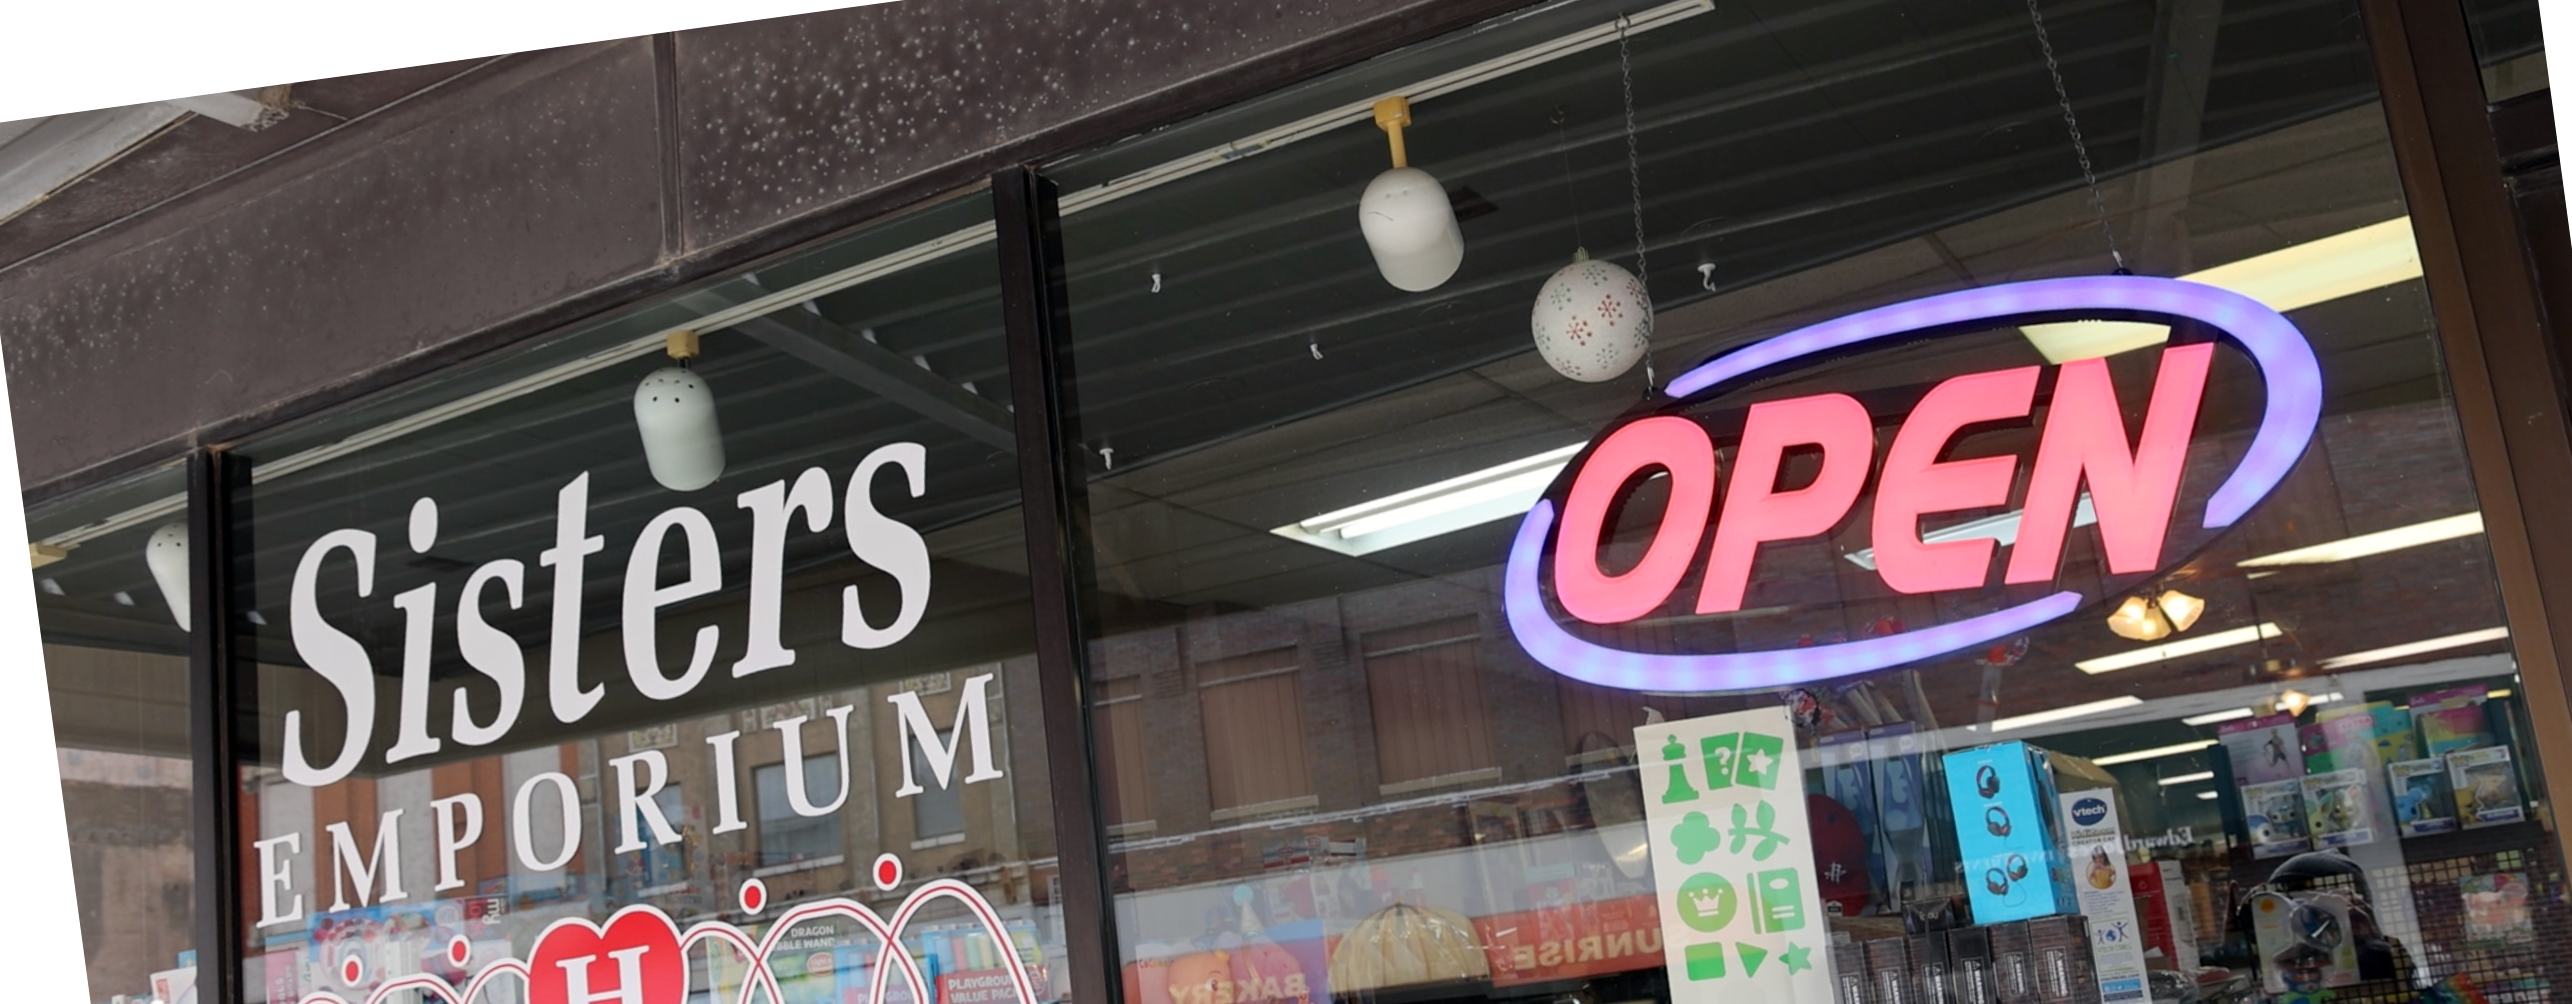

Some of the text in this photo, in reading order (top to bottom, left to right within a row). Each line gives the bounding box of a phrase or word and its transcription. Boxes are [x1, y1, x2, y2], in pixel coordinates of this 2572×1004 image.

[1555, 342, 2216, 624] OPEN
[282, 442, 931, 787] Sisters
[254, 673, 1004, 928] EMPORIUM
[2073, 804, 2106, 817] vtech
[777, 937, 835, 951] BBLE WAND
[790, 925, 834, 938] DRAGON
[2055, 959, 2068, 996] WARNING
[950, 989, 988, 1004] VALUE
